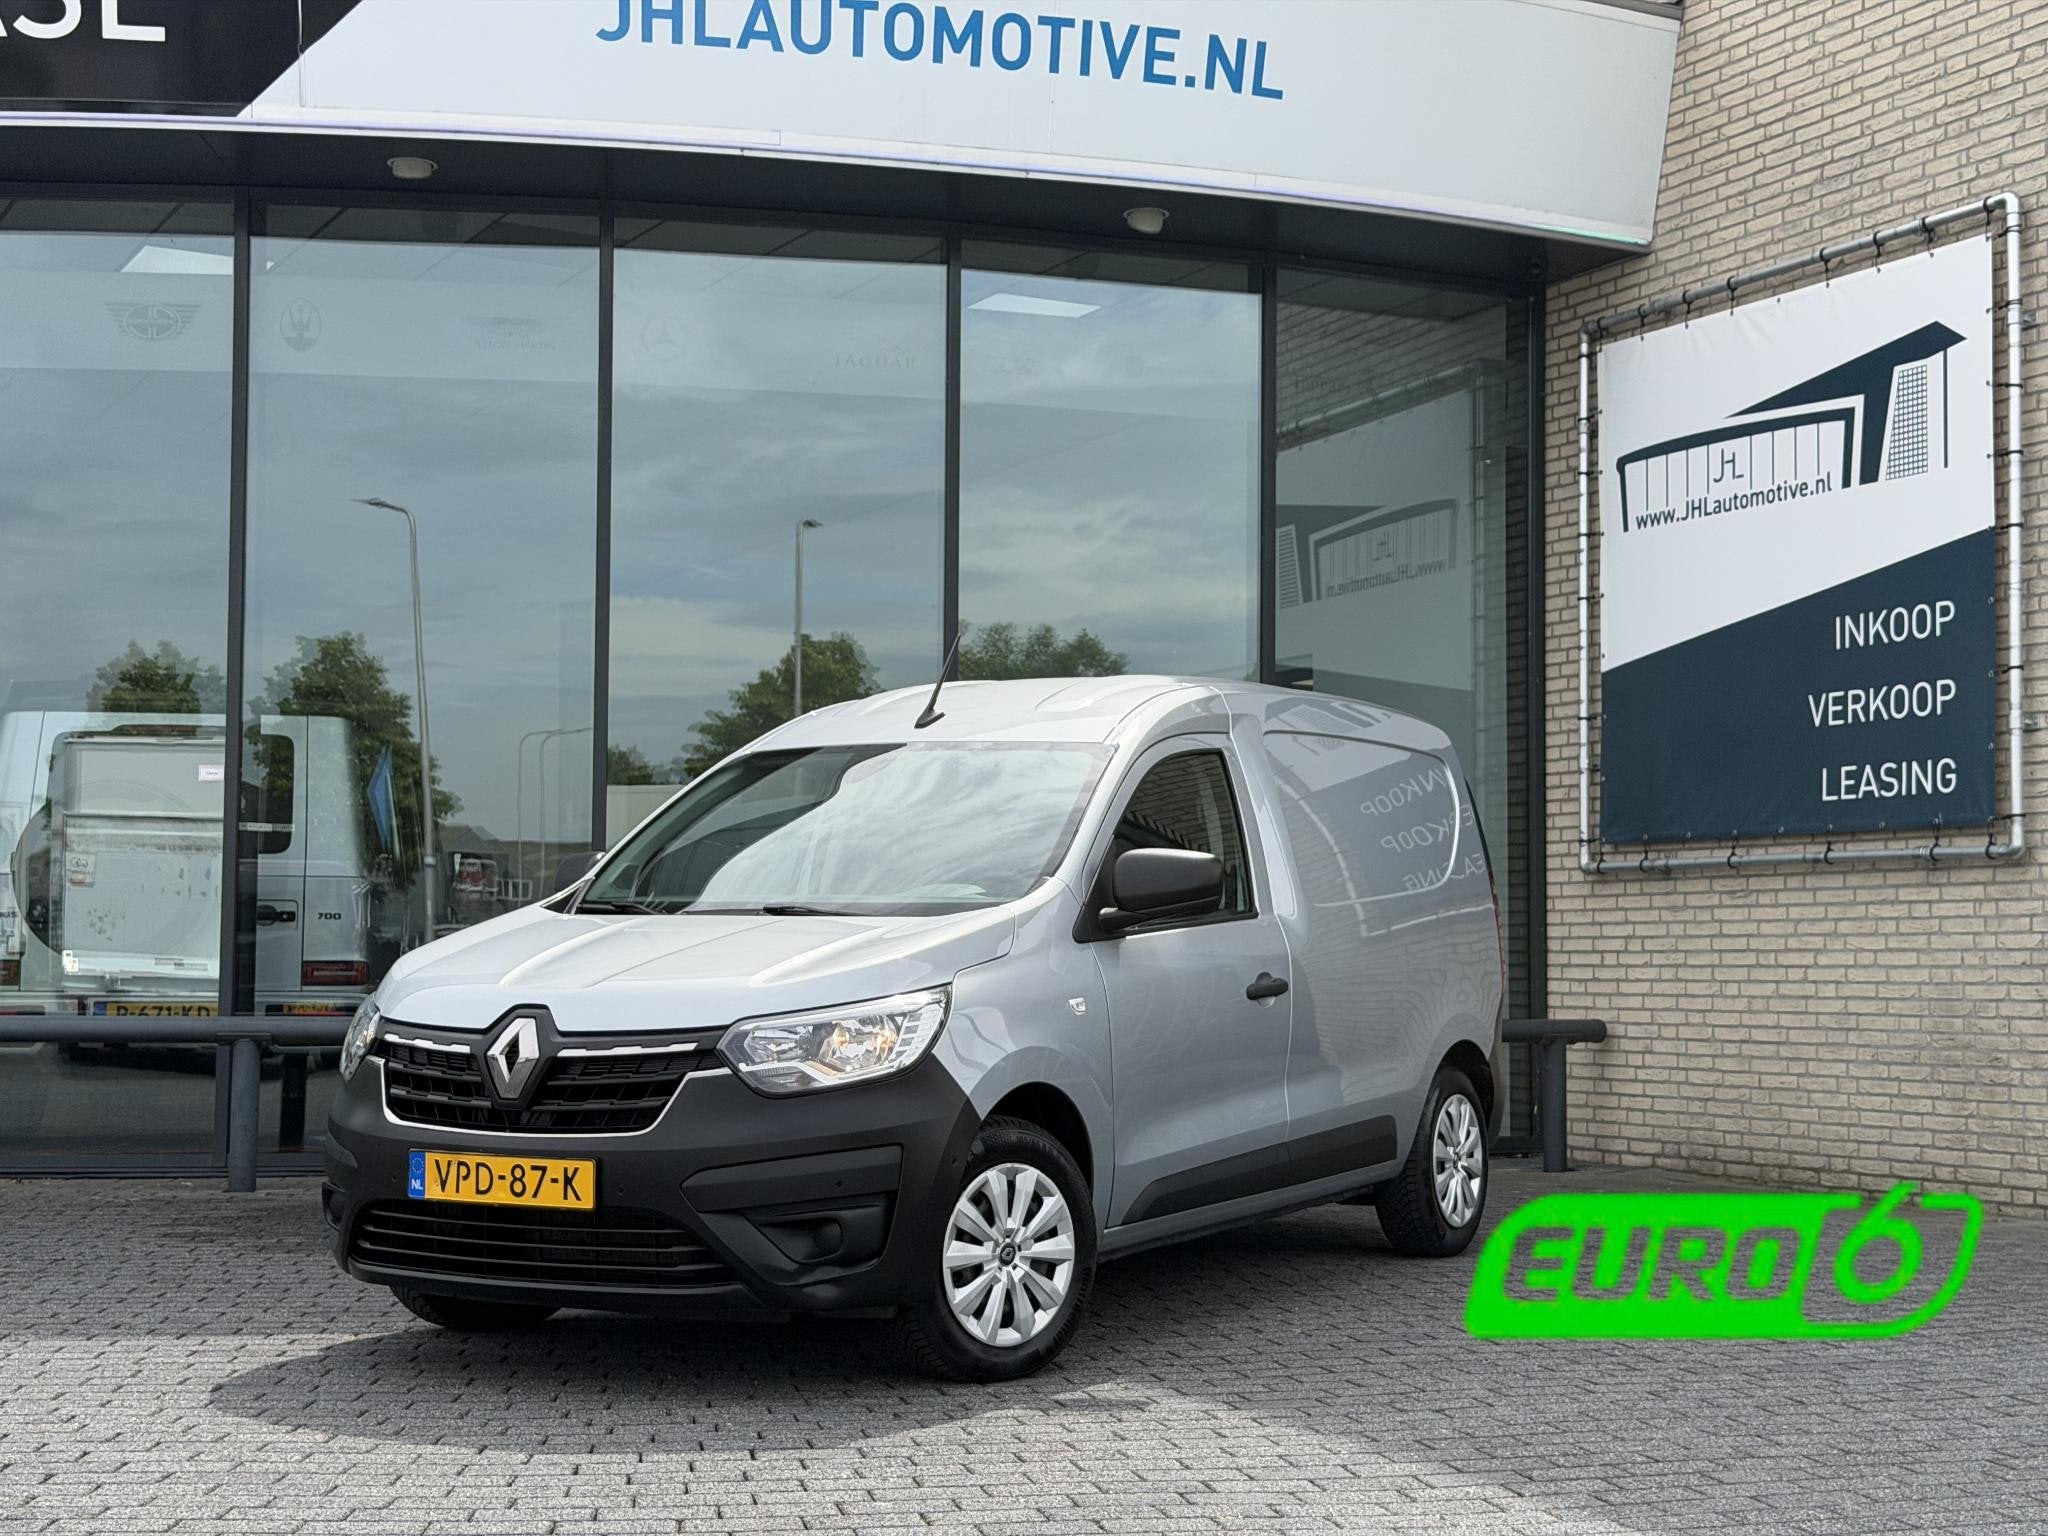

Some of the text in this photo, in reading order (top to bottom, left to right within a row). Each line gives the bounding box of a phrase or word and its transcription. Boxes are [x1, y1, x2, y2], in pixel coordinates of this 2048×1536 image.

[596, 0, 1284, 100] JHLAUTOMOTIVE.NL
[1636, 472, 1832, 529] www.JHLautomotive.nl
[1835, 600, 1956, 650] INKOOP
[1808, 679, 1957, 728] VERKOOP
[1822, 757, 1957, 801] LEASING
[317, 912, 342, 920] 700
[411, 1159, 583, 1202] NL VPD-87-K
